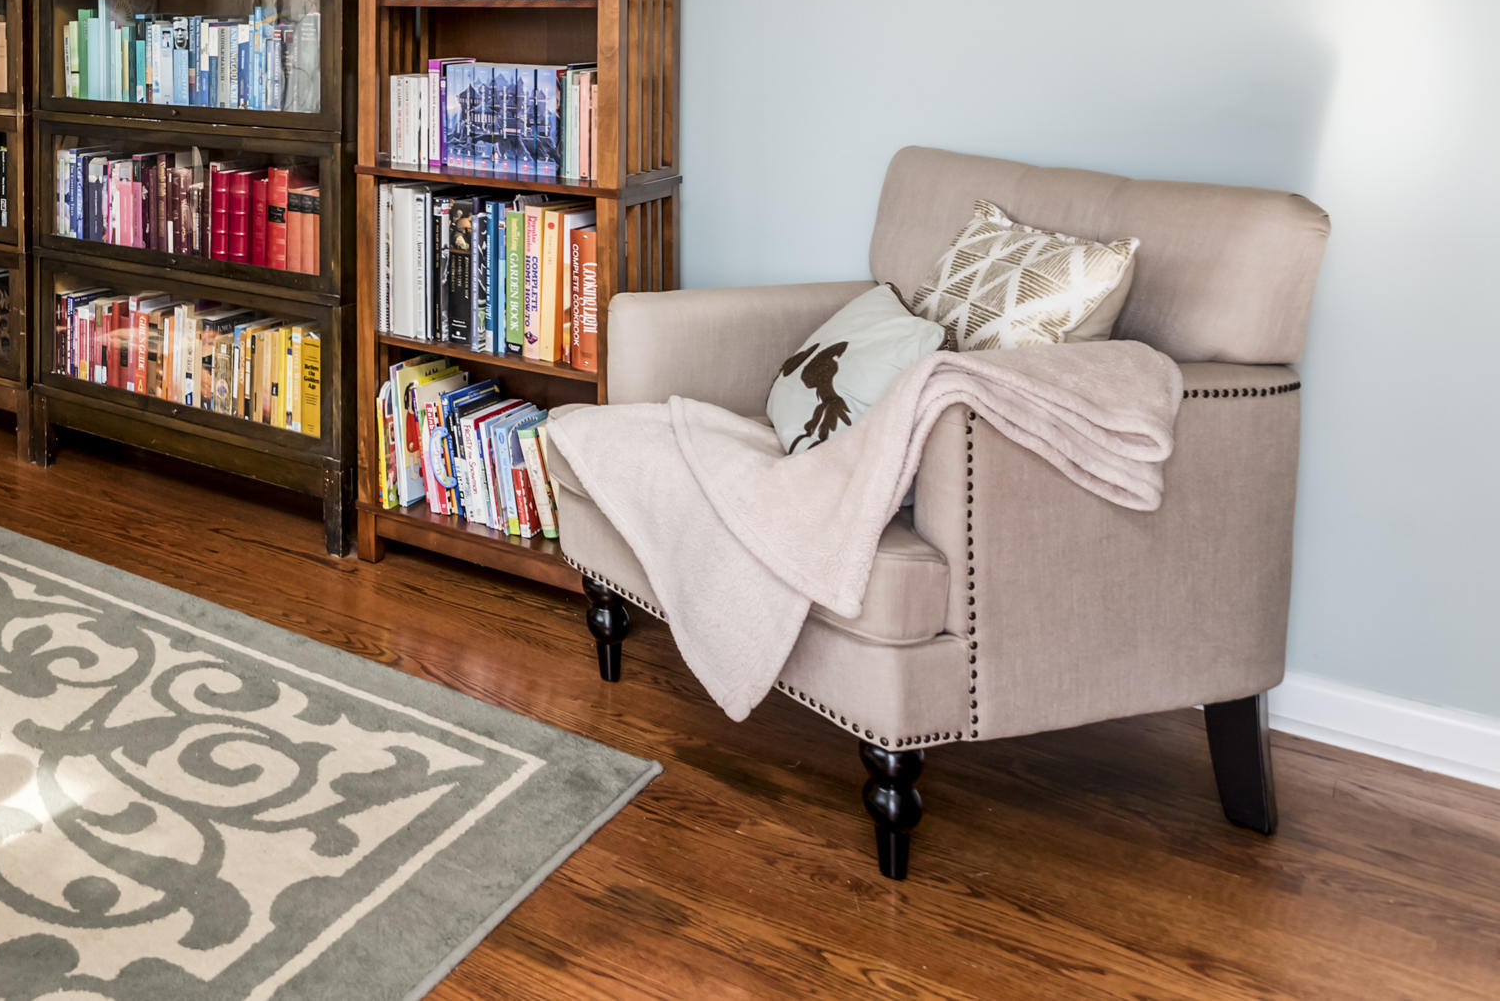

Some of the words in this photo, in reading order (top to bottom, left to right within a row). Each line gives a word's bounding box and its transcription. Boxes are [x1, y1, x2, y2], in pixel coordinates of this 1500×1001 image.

[509, 252, 519, 299] GARDEN
[531, 256, 539, 312] COMPLETE
[572, 243, 580, 292] COMPLETE
[580, 262, 597, 306] Cooking
[509, 300, 519, 332] BOOK
[572, 294, 580, 347] COOKBOOK
[580, 307, 598, 334] Light
